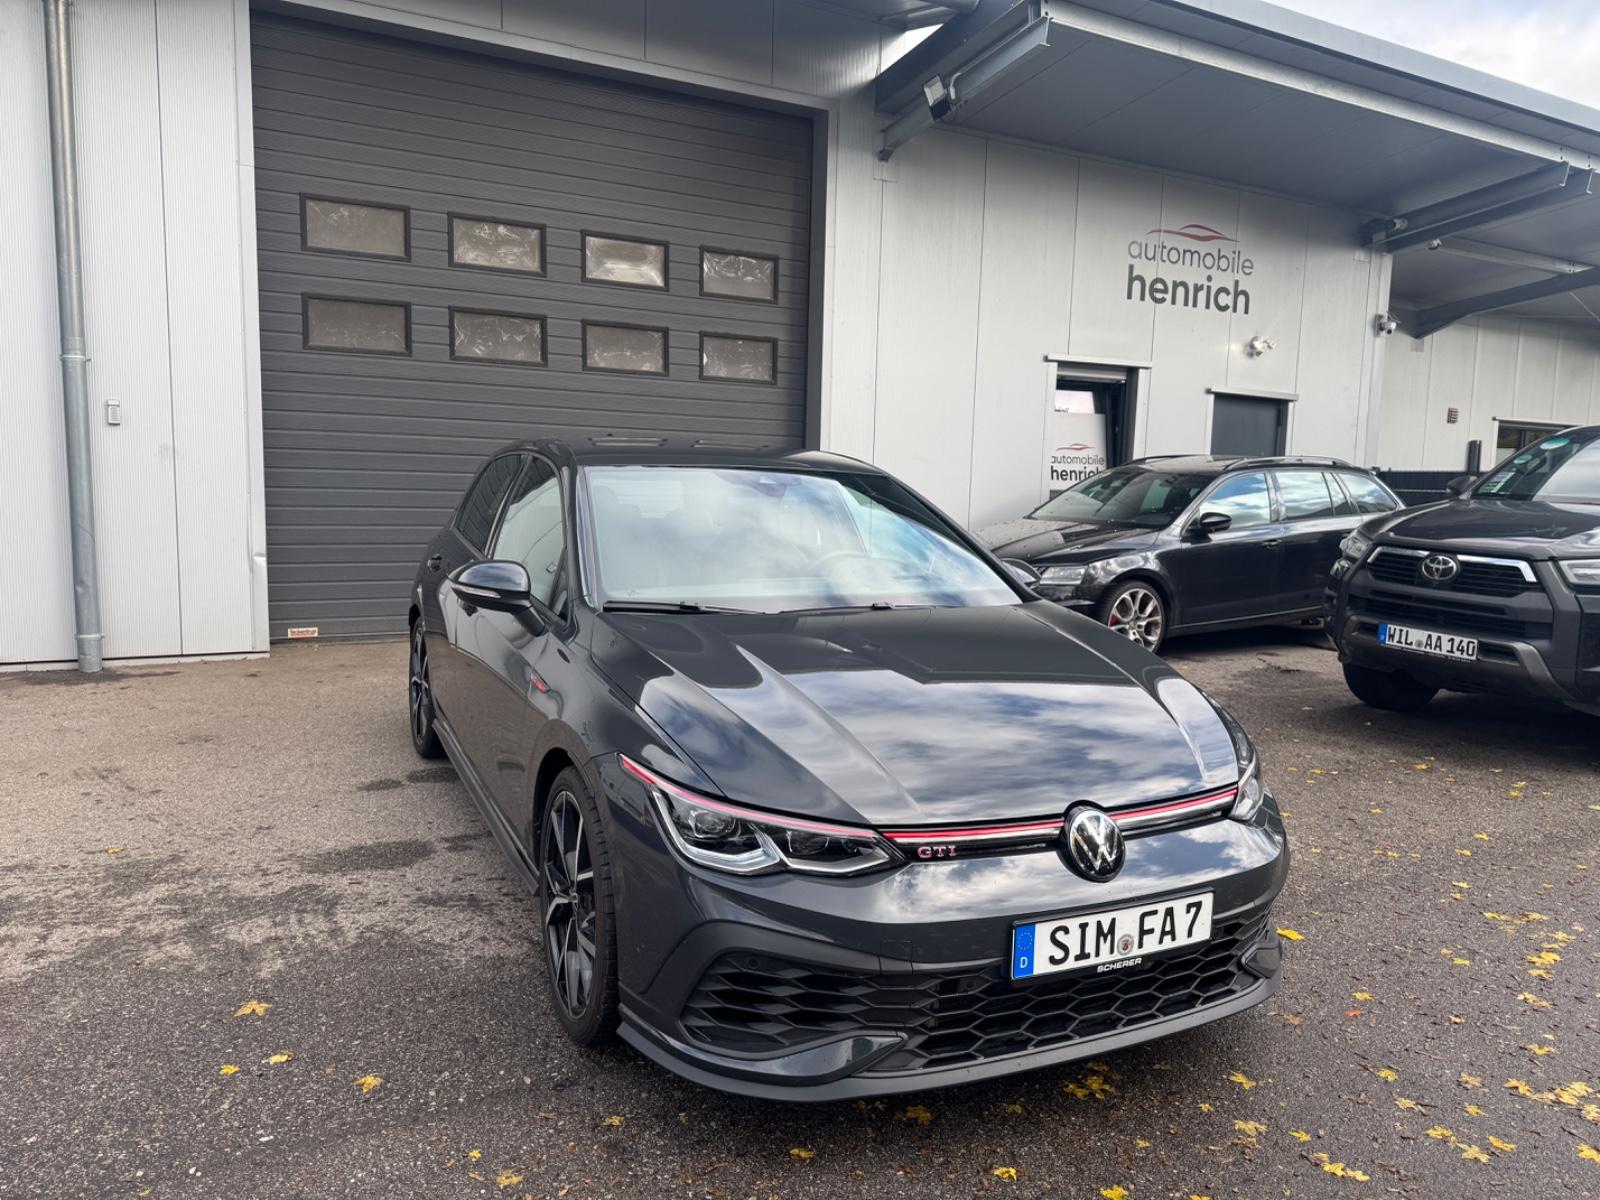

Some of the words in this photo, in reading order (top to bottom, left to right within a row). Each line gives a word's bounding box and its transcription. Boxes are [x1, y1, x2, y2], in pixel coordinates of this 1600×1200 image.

[1128, 240, 1254, 276] automobile
[1126, 264, 1250, 314] henrich
[1051, 454, 1105, 465] automobile
[1424, 633, 1442, 652] AA
[1446, 637, 1476, 657] 140
[917, 845, 957, 858] GTI
[1049, 917, 1117, 966] SIM
[1138, 906, 1177, 949] FA
[1185, 900, 1203, 938] 7
[1019, 956, 1029, 969] D
[1096, 957, 1142, 973] SCHERER
